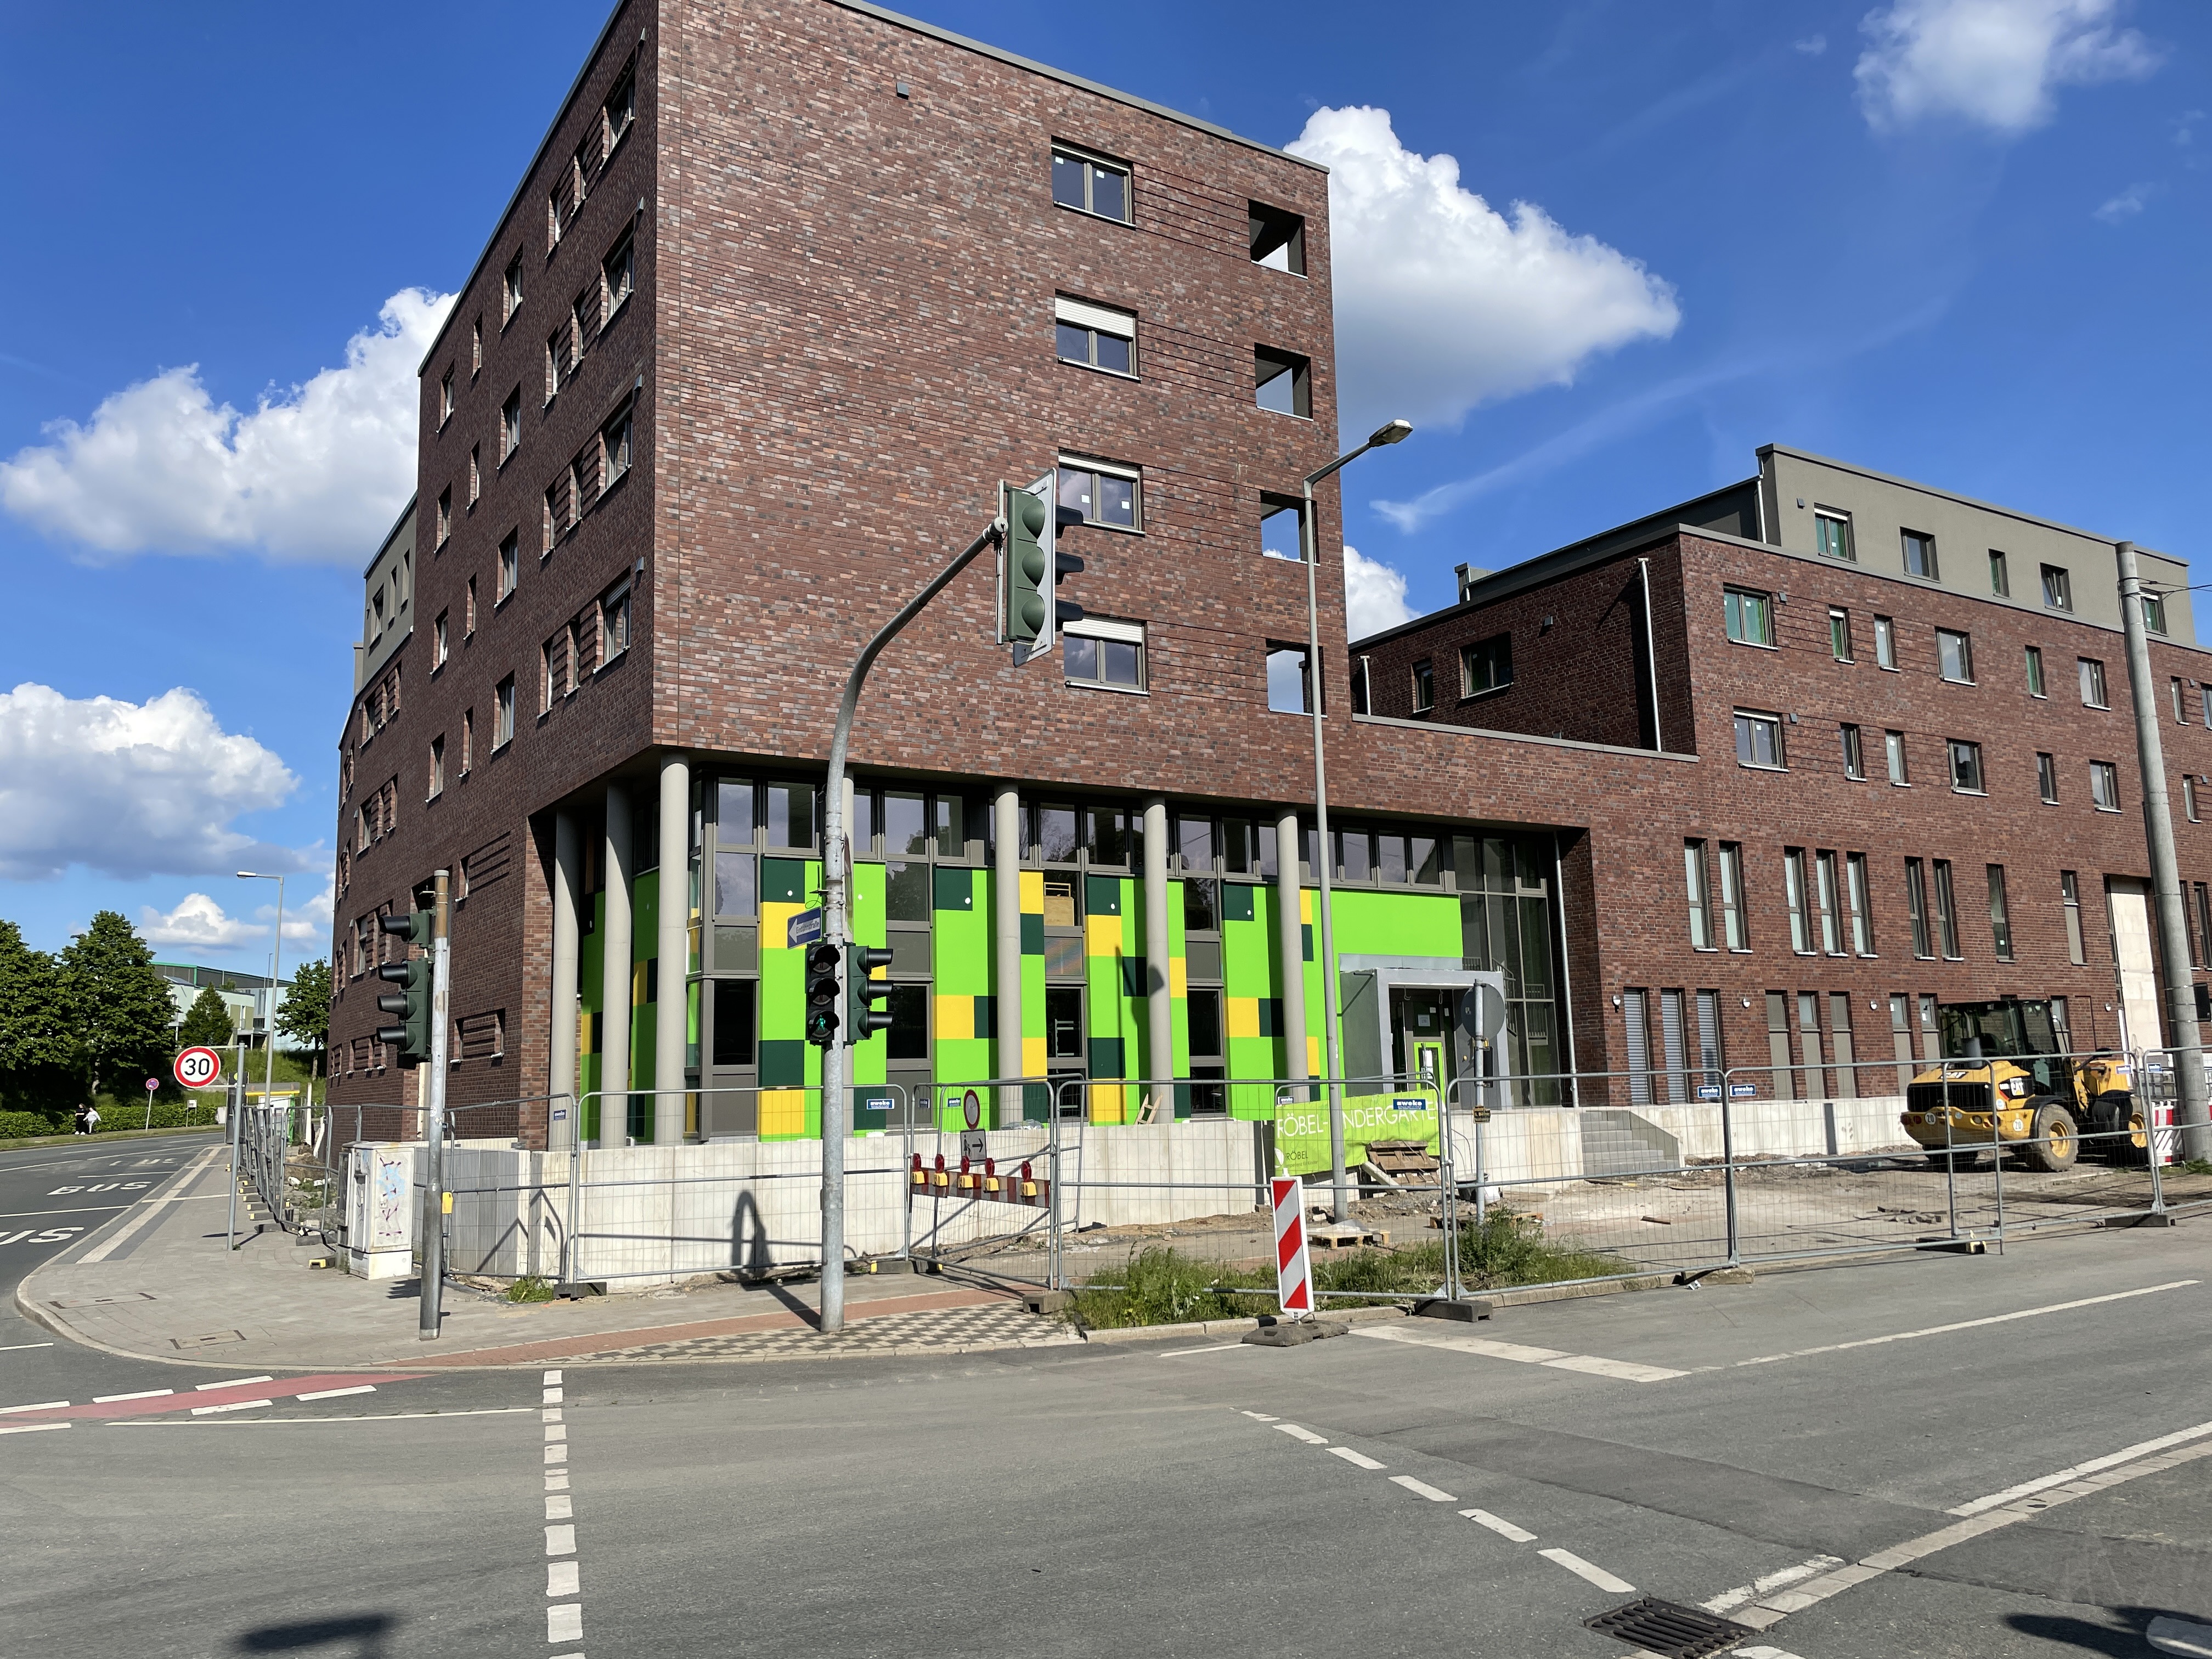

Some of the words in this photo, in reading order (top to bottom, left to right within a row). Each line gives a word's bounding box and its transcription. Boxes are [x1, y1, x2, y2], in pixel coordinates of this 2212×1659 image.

[184, 1058, 210, 1075] 30
[2011, 1082, 2024, 1095] CAT
[1926, 1114, 1934, 1122] 20
[2015, 1121, 2022, 1129] 20
[47, 1181, 153, 1195] BUS
[0, 1227, 84, 1245] US
